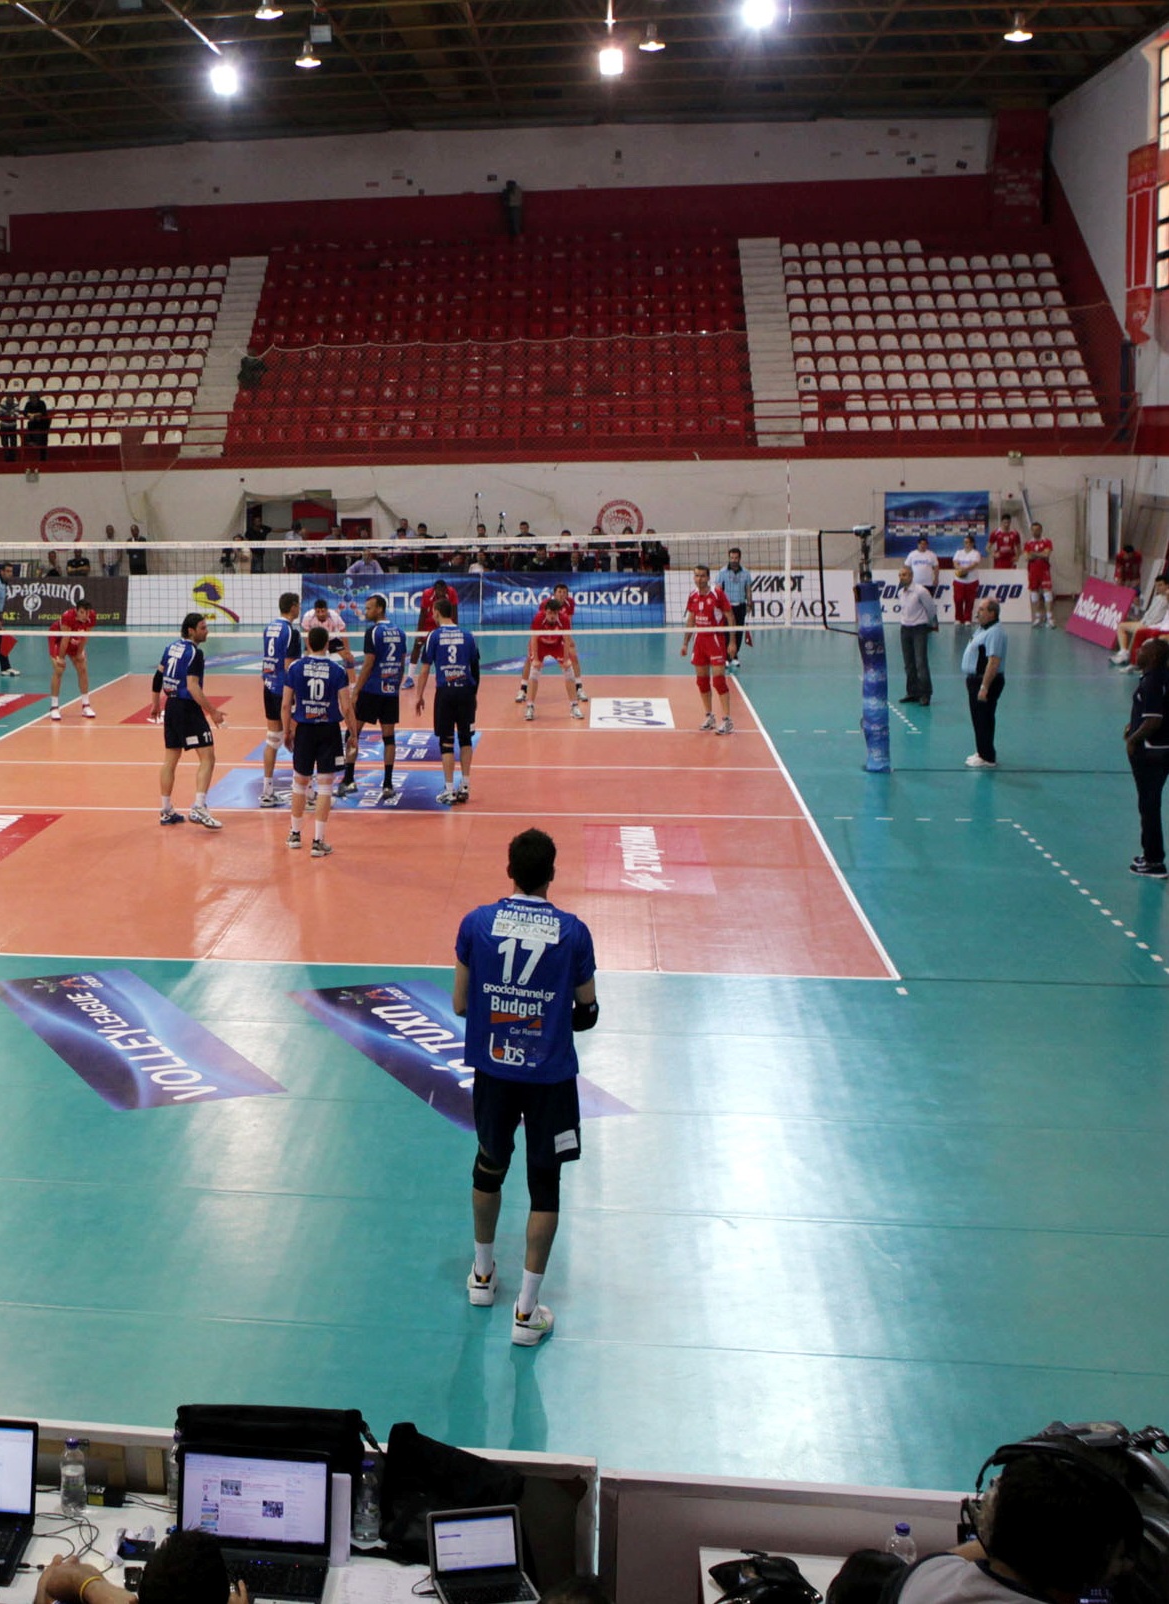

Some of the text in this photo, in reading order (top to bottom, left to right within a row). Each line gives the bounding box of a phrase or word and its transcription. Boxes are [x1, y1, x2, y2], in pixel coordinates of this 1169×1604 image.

[572, 586, 649, 606] αιχνίδι
[268, 637, 275, 657] 6
[386, 643, 396, 662] 2
[448, 645, 458, 664] 3
[307, 679, 325, 701] 10
[497, 937, 546, 986] 17
[483, 982, 557, 1002] goodchannel.gr
[490, 995, 543, 1018] Budget
[509, 1026, 521, 1035] Car
[66, 993, 218, 1101] VOLLEY LEAGUE
